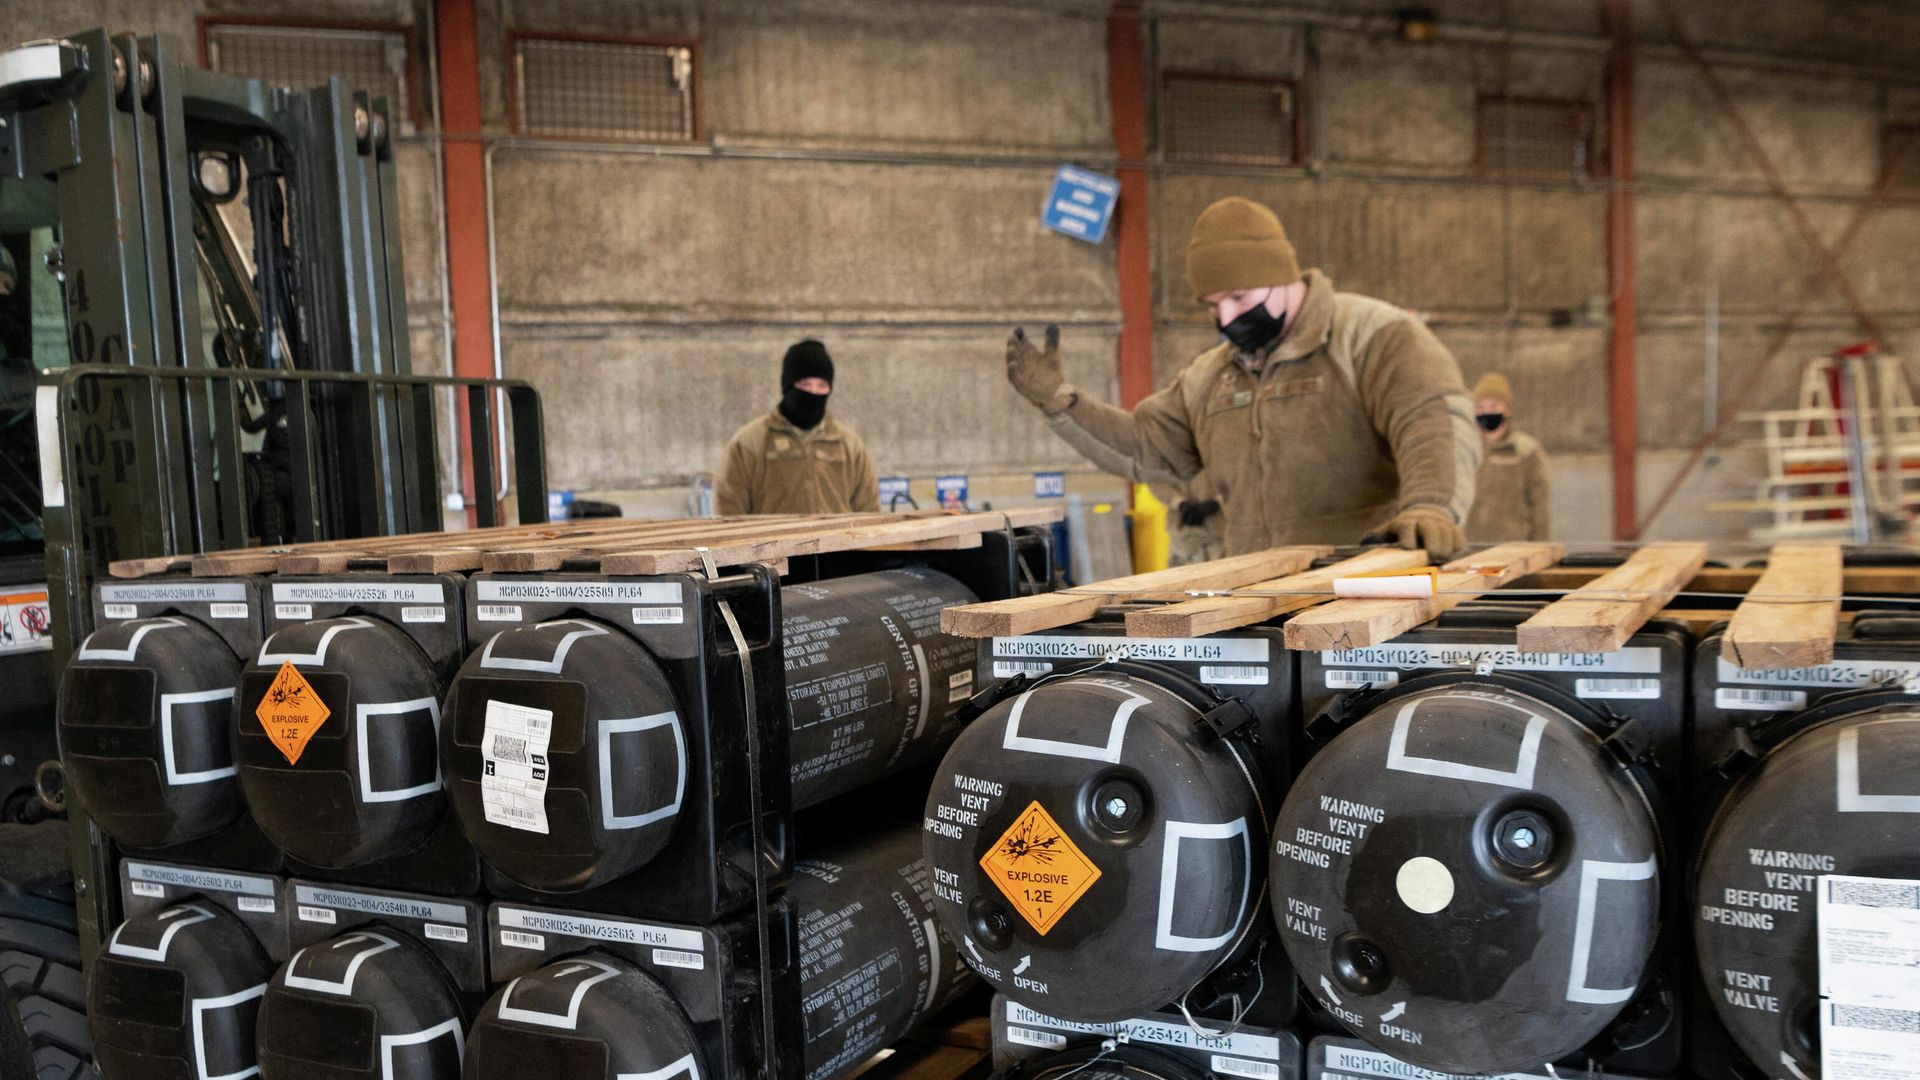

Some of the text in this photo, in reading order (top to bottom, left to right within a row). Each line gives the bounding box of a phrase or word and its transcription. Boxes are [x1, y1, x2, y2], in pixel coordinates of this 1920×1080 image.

[393, 589, 416, 600] PL64
[617, 586, 642, 598] PL64
[881, 615, 915, 672] CENTER
[908, 677, 919, 699] OF
[1183, 644, 1222, 659] PL64
[1558, 653, 1605, 666] PL64
[790, 683, 823, 701] STORAGE
[820, 671, 867, 692] TEMPERATURE
[828, 693, 838, 704] TO
[850, 686, 863, 697] DEG
[832, 704, 842, 715] TO
[850, 698, 863, 710] DEG
[272, 715, 309, 724] EXPLOSIVE
[281, 729, 298, 739] 1.2E
[289, 743, 293, 751] 1
[954, 774, 1003, 797] WARNING
[961, 793, 989, 812] VENT
[1320, 794, 1385, 824] WARNING
[938, 804, 978, 827] BEFORE
[925, 817, 963, 840] OPENING
[1329, 816, 1367, 840] VENT
[1296, 827, 1352, 856] BEFORE
[1276, 840, 1330, 869] OPENING
[1749, 848, 1836, 872] WARNING
[934, 867, 959, 887] VENT
[1007, 870, 1068, 885] EXPLOSIVE
[1764, 871, 1816, 892] VENT
[933, 882, 963, 905] VALVE
[1023, 889, 1053, 904] 1.2E
[1725, 888, 1799, 912] BEFORE
[411, 906, 432, 918] PL64
[1036, 908, 1042, 919] 1
[1288, 896, 1322, 921] VENT
[1701, 905, 1774, 930] OPENING
[643, 931, 668, 944] PL64
[890, 890, 926, 949] CENTER
[918, 954, 930, 975] OF
[1285, 914, 1327, 942] VALVE
[966, 957, 1002, 982] CLOSE
[1724, 969, 1772, 992] VENT
[805, 953, 898, 1013] STORAGE TEMPERATURE LIMITS
[1014, 976, 1049, 995] OPEN
[842, 994, 851, 1006] TO
[846, 1003, 855, 1016] TO
[1724, 988, 1780, 1013] VALVE
[1319, 997, 1364, 1028] CLOSE
[1195, 1033, 1232, 1049] PL64
[1379, 1022, 1423, 1045] OPEN
